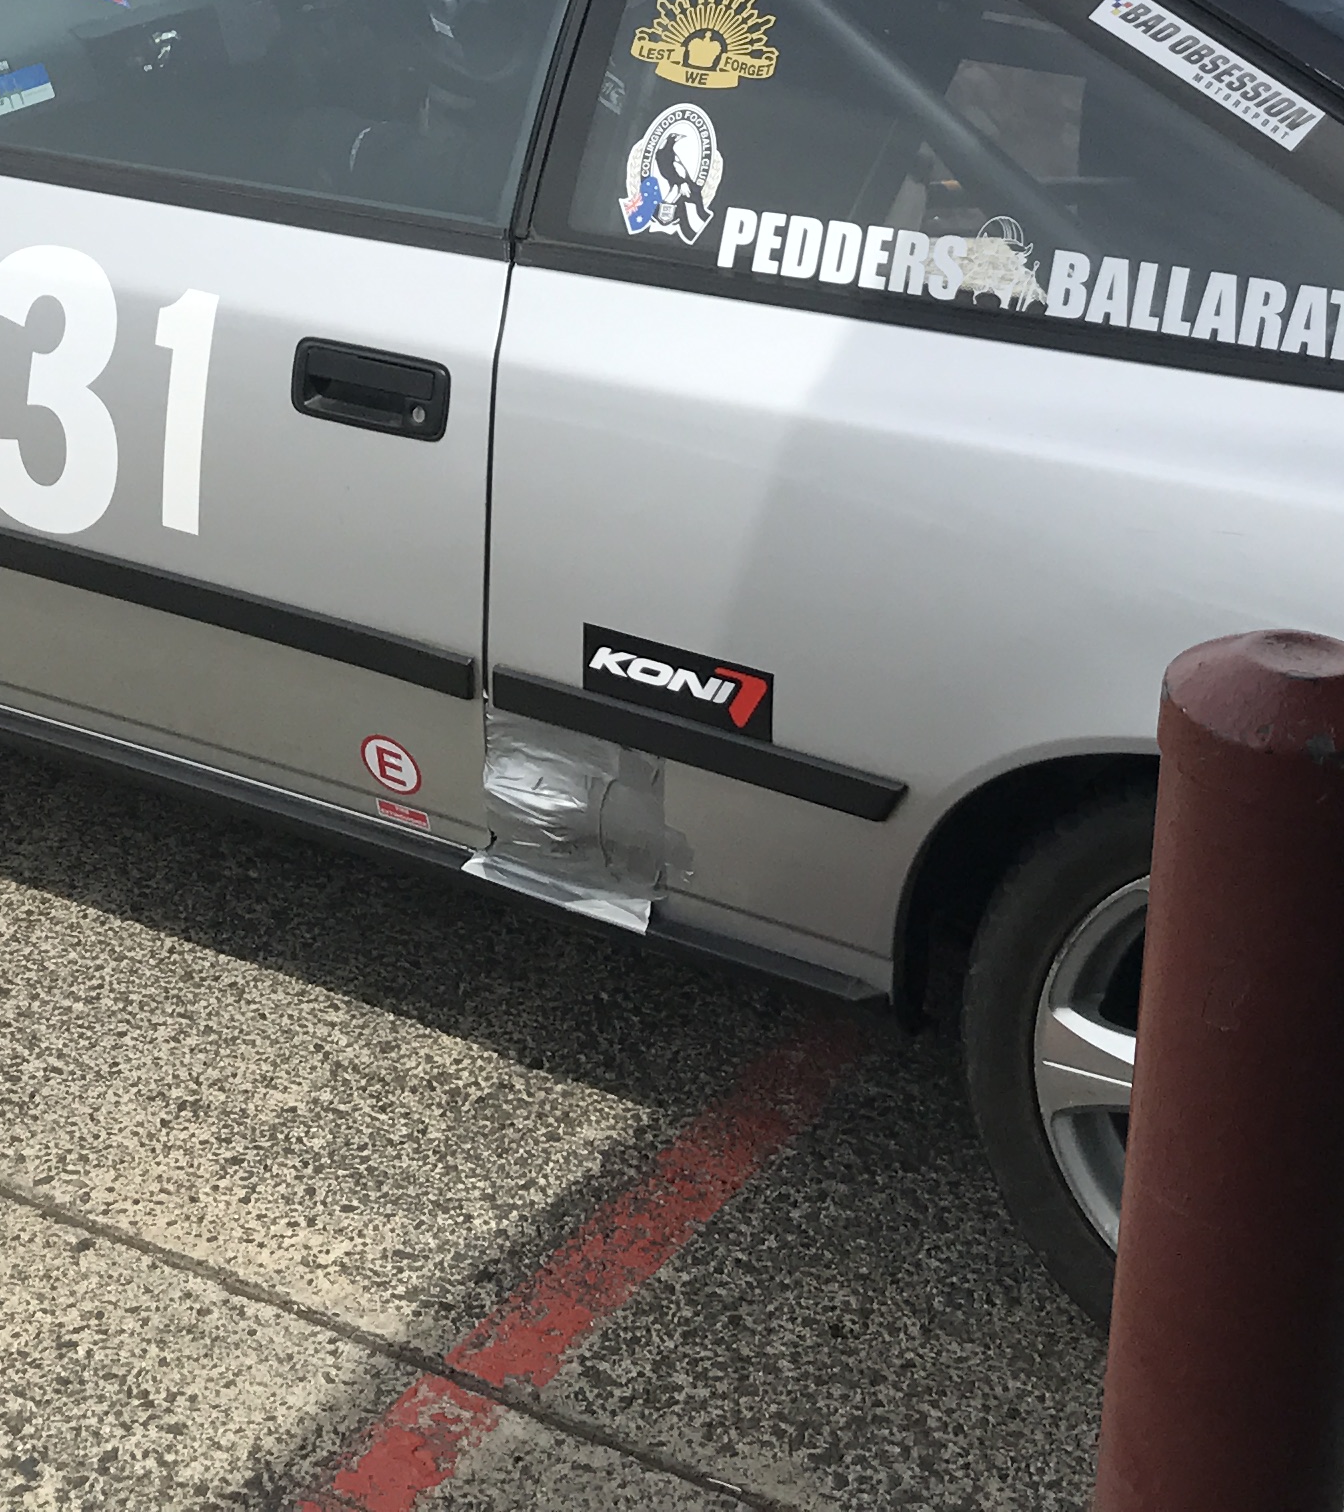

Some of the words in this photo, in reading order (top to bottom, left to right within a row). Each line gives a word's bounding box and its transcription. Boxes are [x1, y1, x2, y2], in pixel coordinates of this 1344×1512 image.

[637, 46, 676, 62] LEST
[684, 70, 710, 85] WE
[723, 56, 774, 77] FORGET
[1118, 2, 1181, 43] BAD
[1167, 34, 1317, 132] OBSESSION
[1192, 73, 1291, 140] MOTORSPORT
[641, 110, 683, 178] COLLINGWOOD
[684, 110, 711, 158] FOOTBALL
[695, 157, 711, 187] CLUB
[716, 206, 968, 301] PEDDERS
[588, 646, 737, 705] KONI
[374, 745, 408, 787] E
